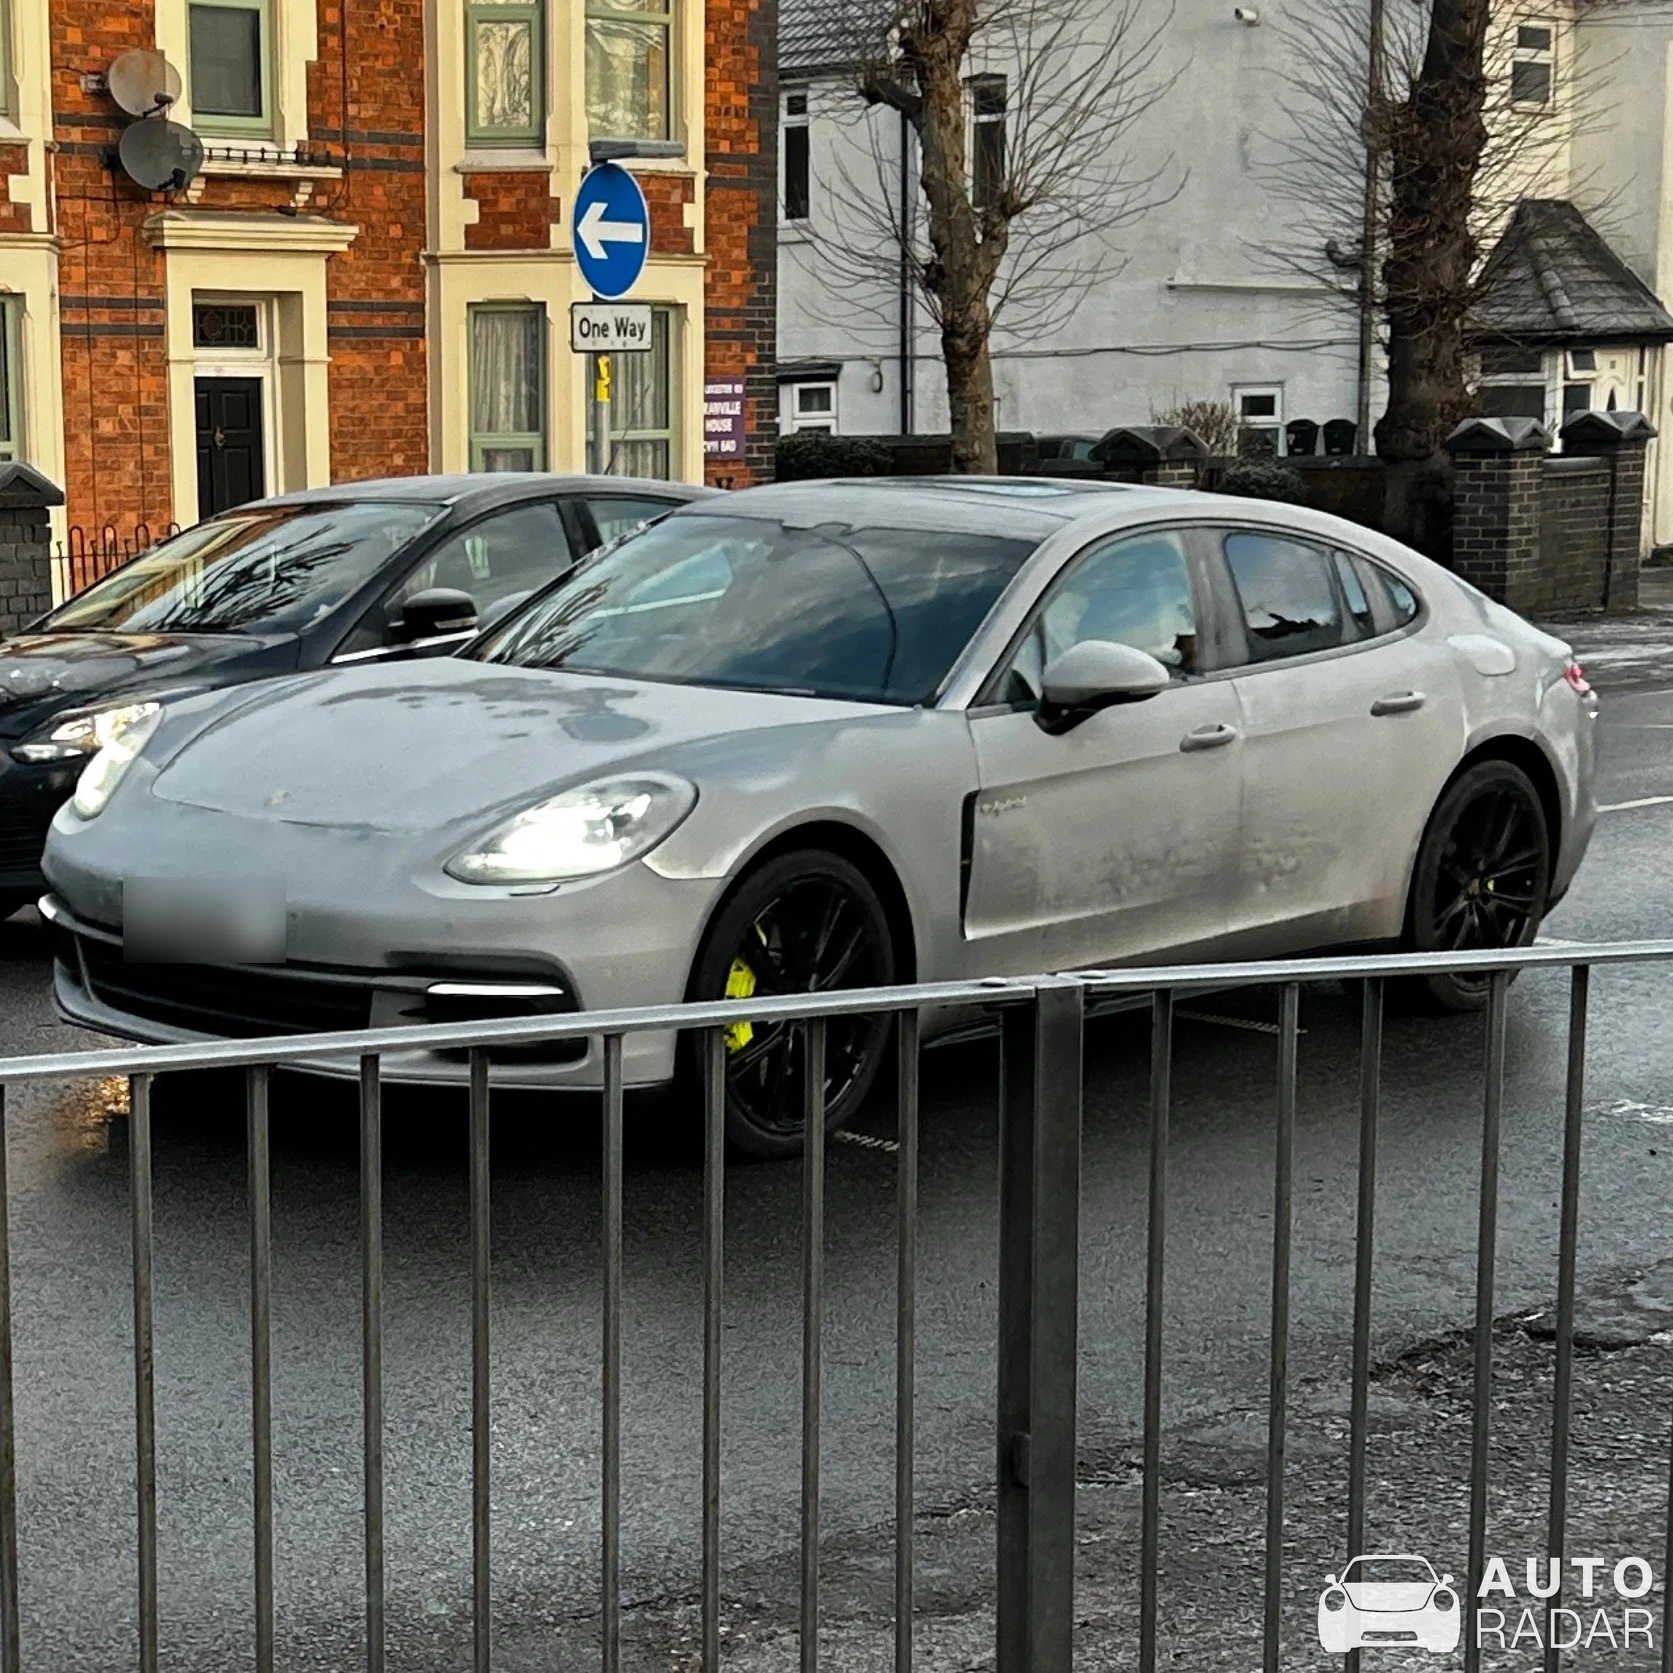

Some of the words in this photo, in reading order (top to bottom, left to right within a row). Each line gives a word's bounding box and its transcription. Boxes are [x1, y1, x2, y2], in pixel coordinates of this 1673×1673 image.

[579, 317, 609, 338] One
[614, 317, 646, 341] Way
[706, 418, 732, 432] HOUSE
